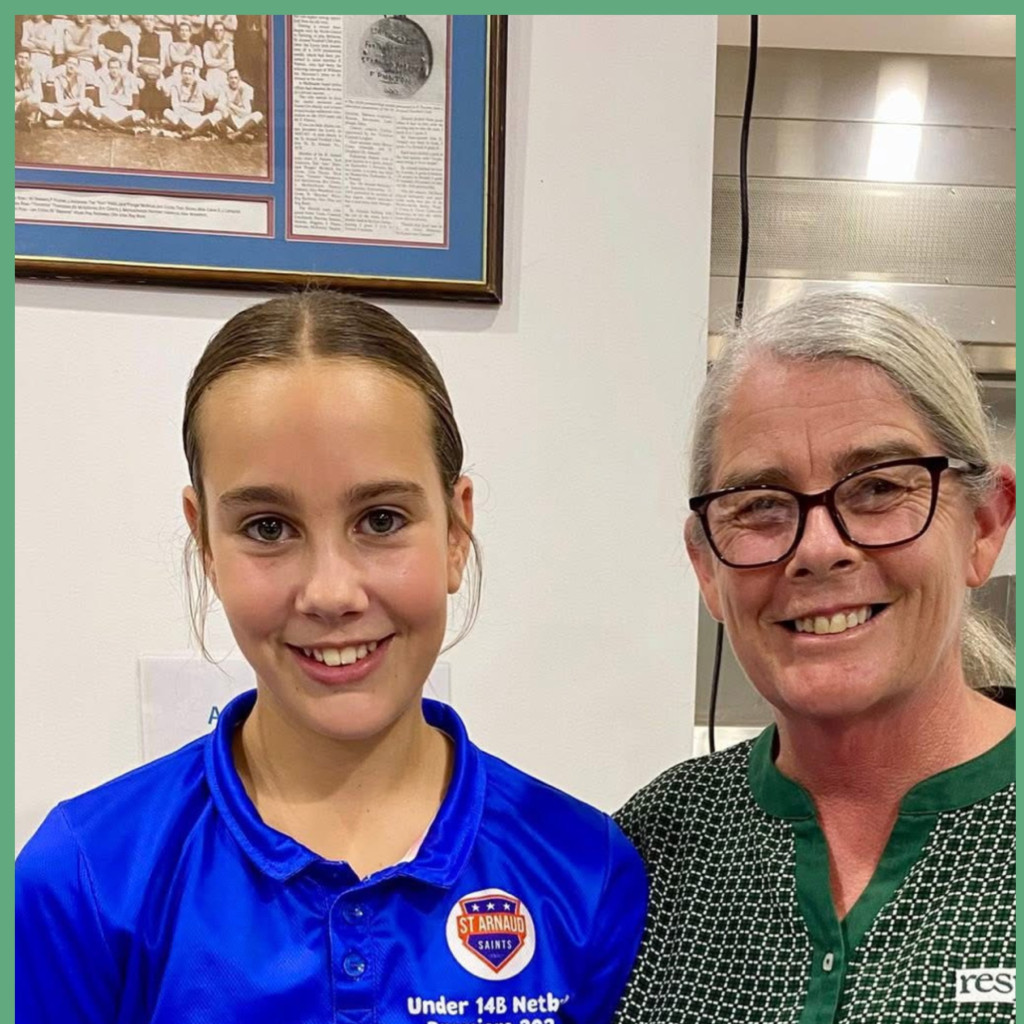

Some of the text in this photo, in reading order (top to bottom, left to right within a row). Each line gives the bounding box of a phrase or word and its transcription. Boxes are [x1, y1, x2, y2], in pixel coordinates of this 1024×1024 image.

[459, 914, 526, 934] ST ARNAUD
[478, 939, 512, 951] SAINTS
[959, 973, 1016, 995] res
[407, 991, 571, 1016] Under 14B Netb
